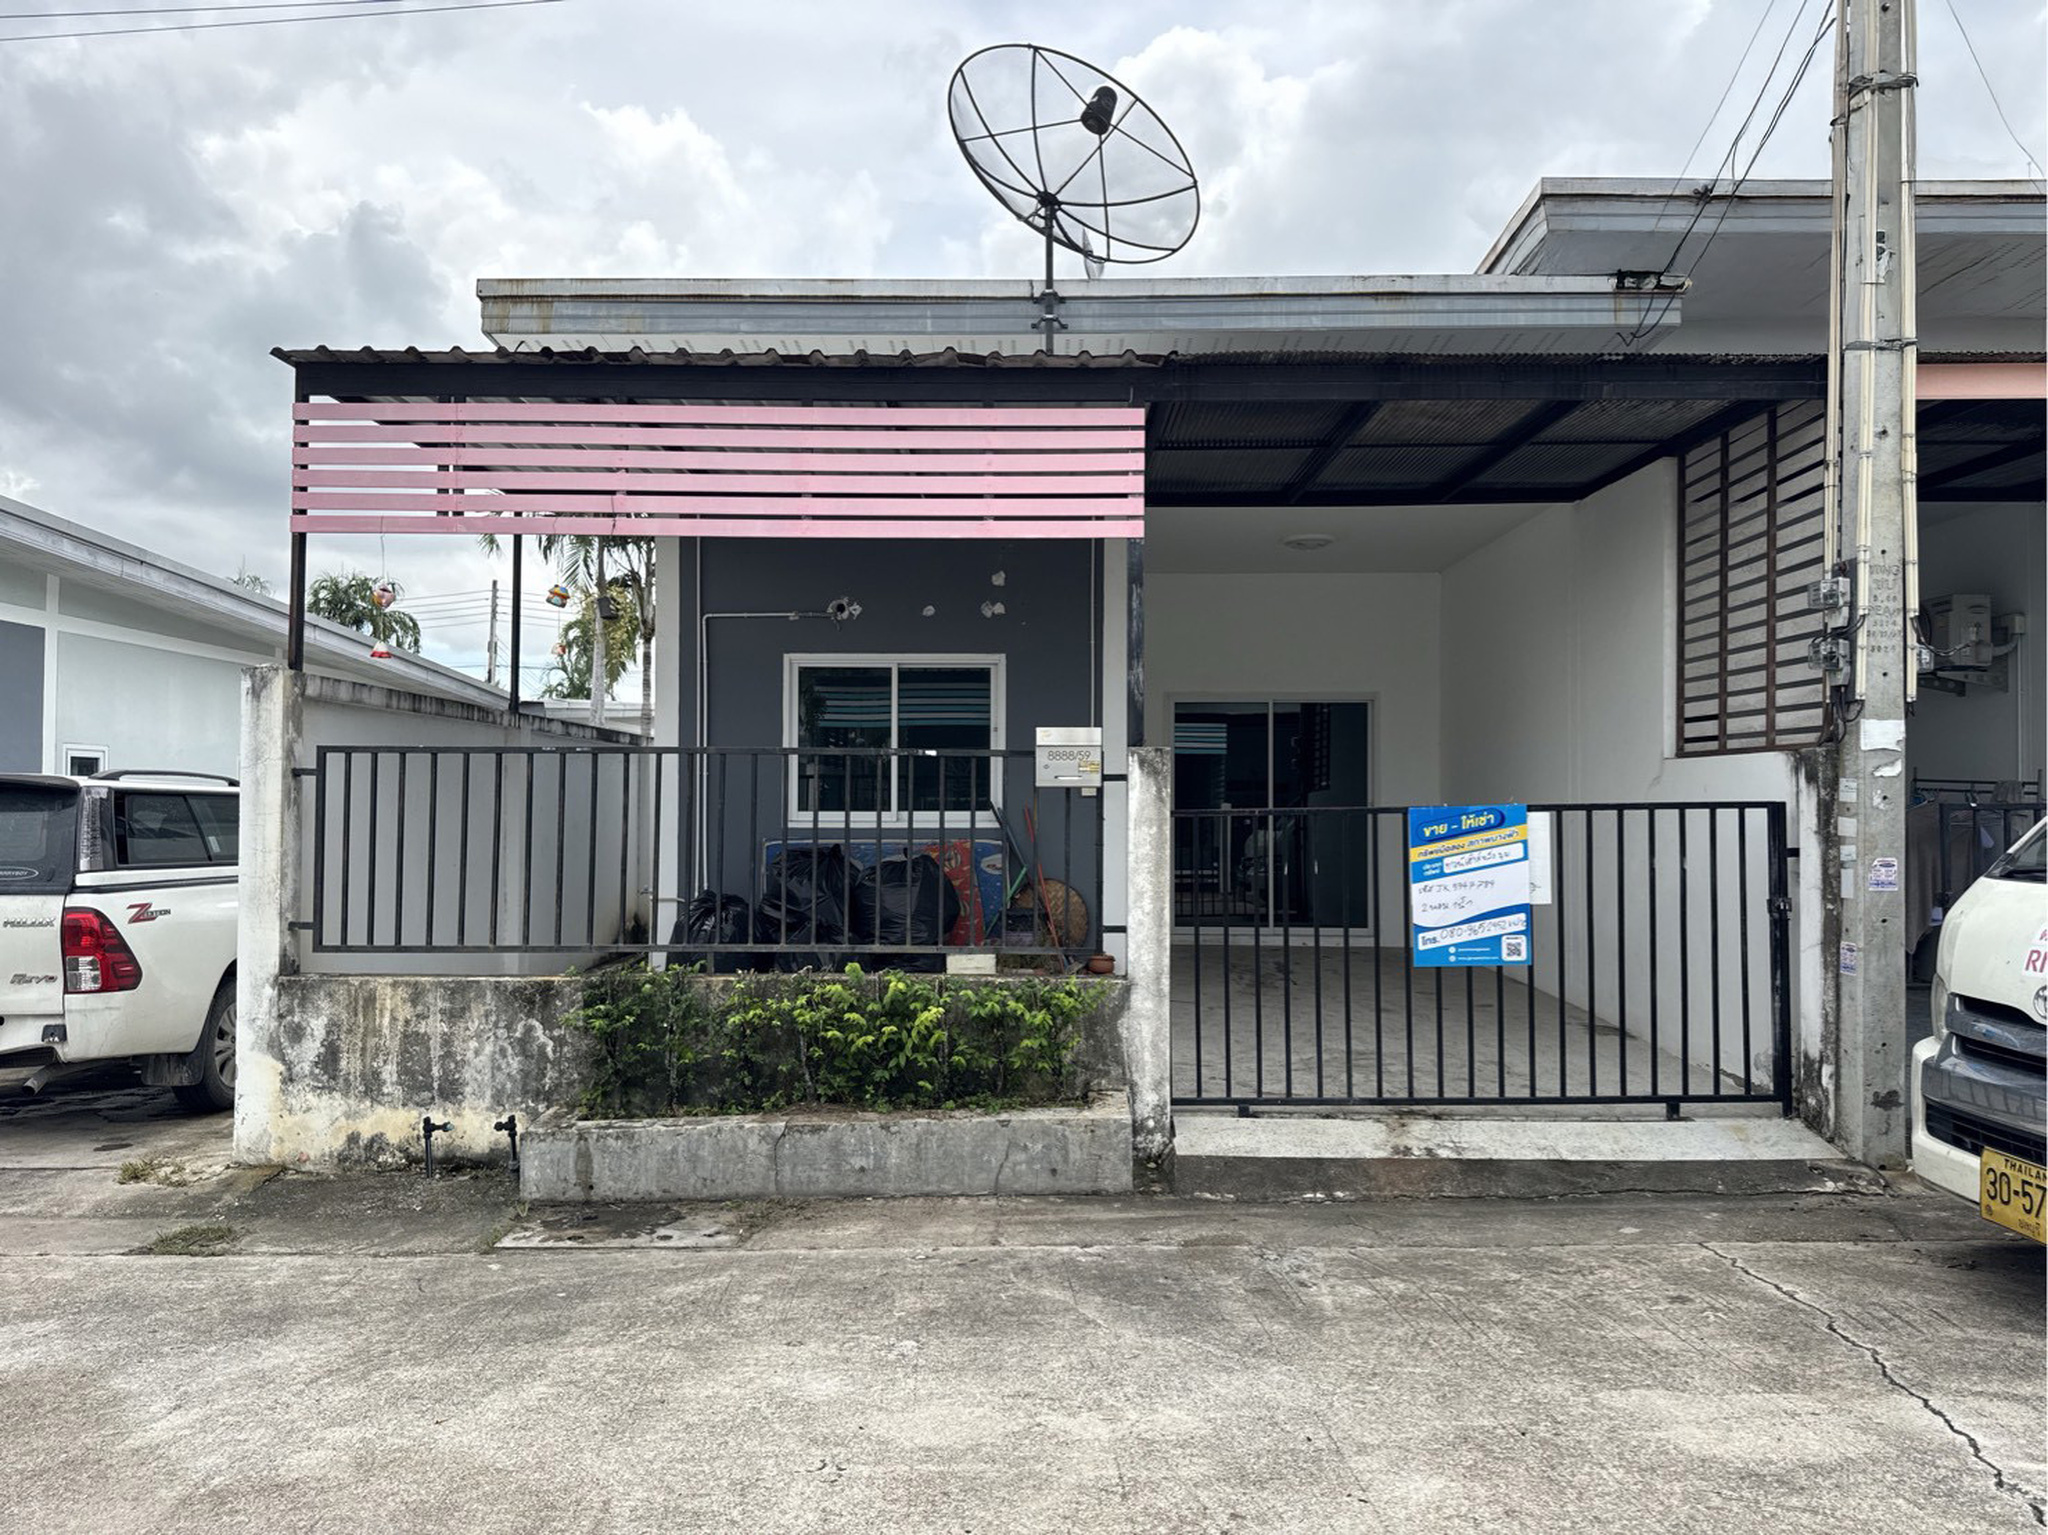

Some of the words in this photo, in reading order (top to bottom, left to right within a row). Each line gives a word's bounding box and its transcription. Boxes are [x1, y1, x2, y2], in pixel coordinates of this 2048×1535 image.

[1047, 750, 1091, 761] 8888/59
[1423, 822, 1448, 837] ขาย
[1461, 811, 1495, 830] ให้เช่า
[126, 902, 157, 924] Z
[1986, 1167, 2047, 1219] 30-57
